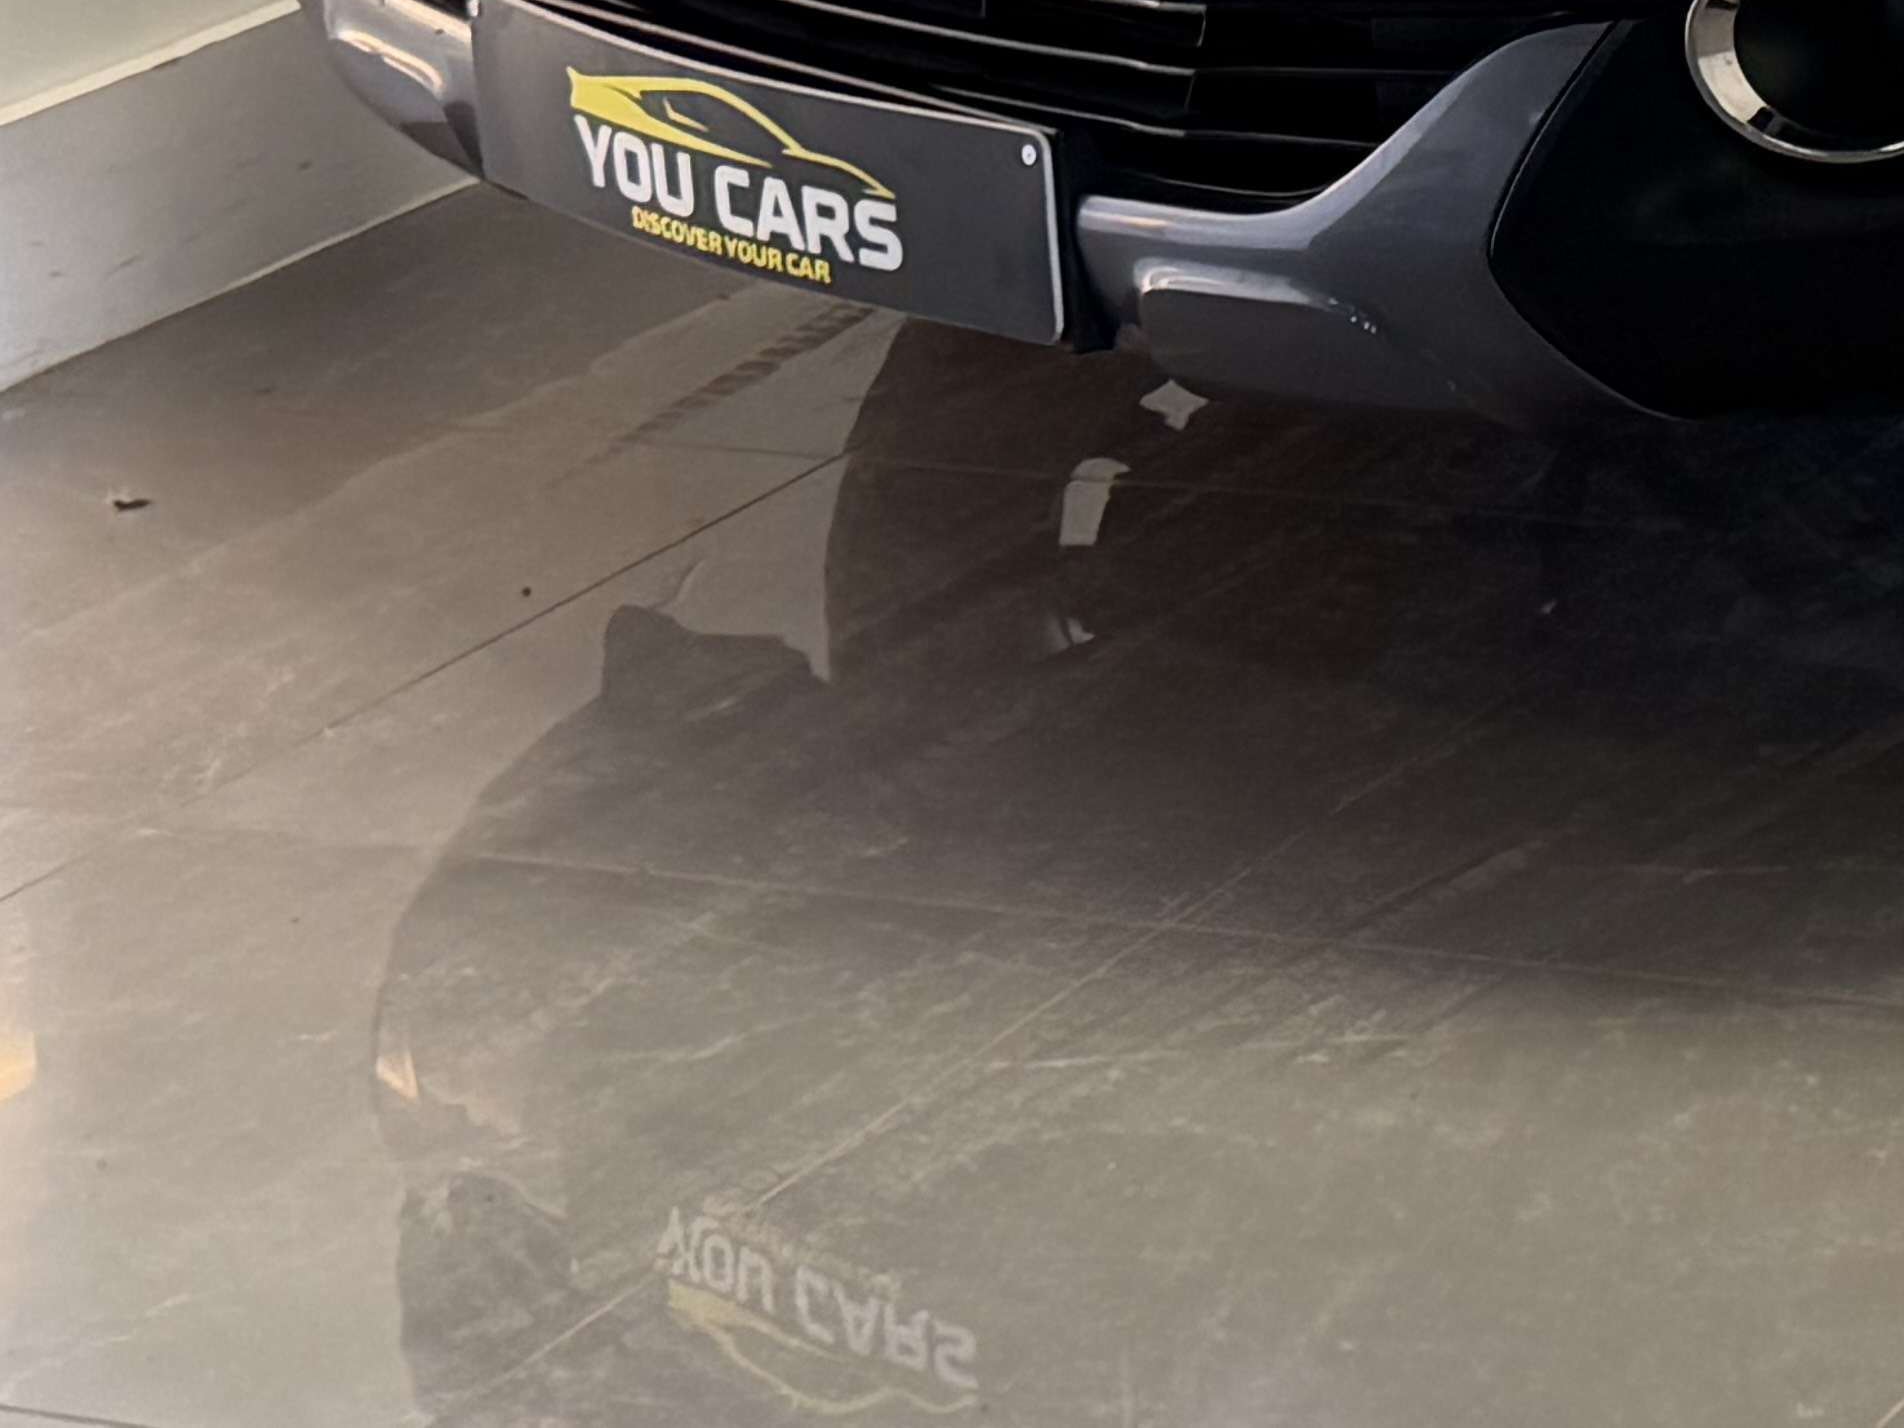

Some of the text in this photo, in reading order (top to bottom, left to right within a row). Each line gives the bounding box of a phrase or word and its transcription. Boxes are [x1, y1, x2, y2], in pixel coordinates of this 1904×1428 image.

[573, 114, 904, 272] YOU CARS
[631, 205, 831, 284] DISCOVER YOUR CAR
